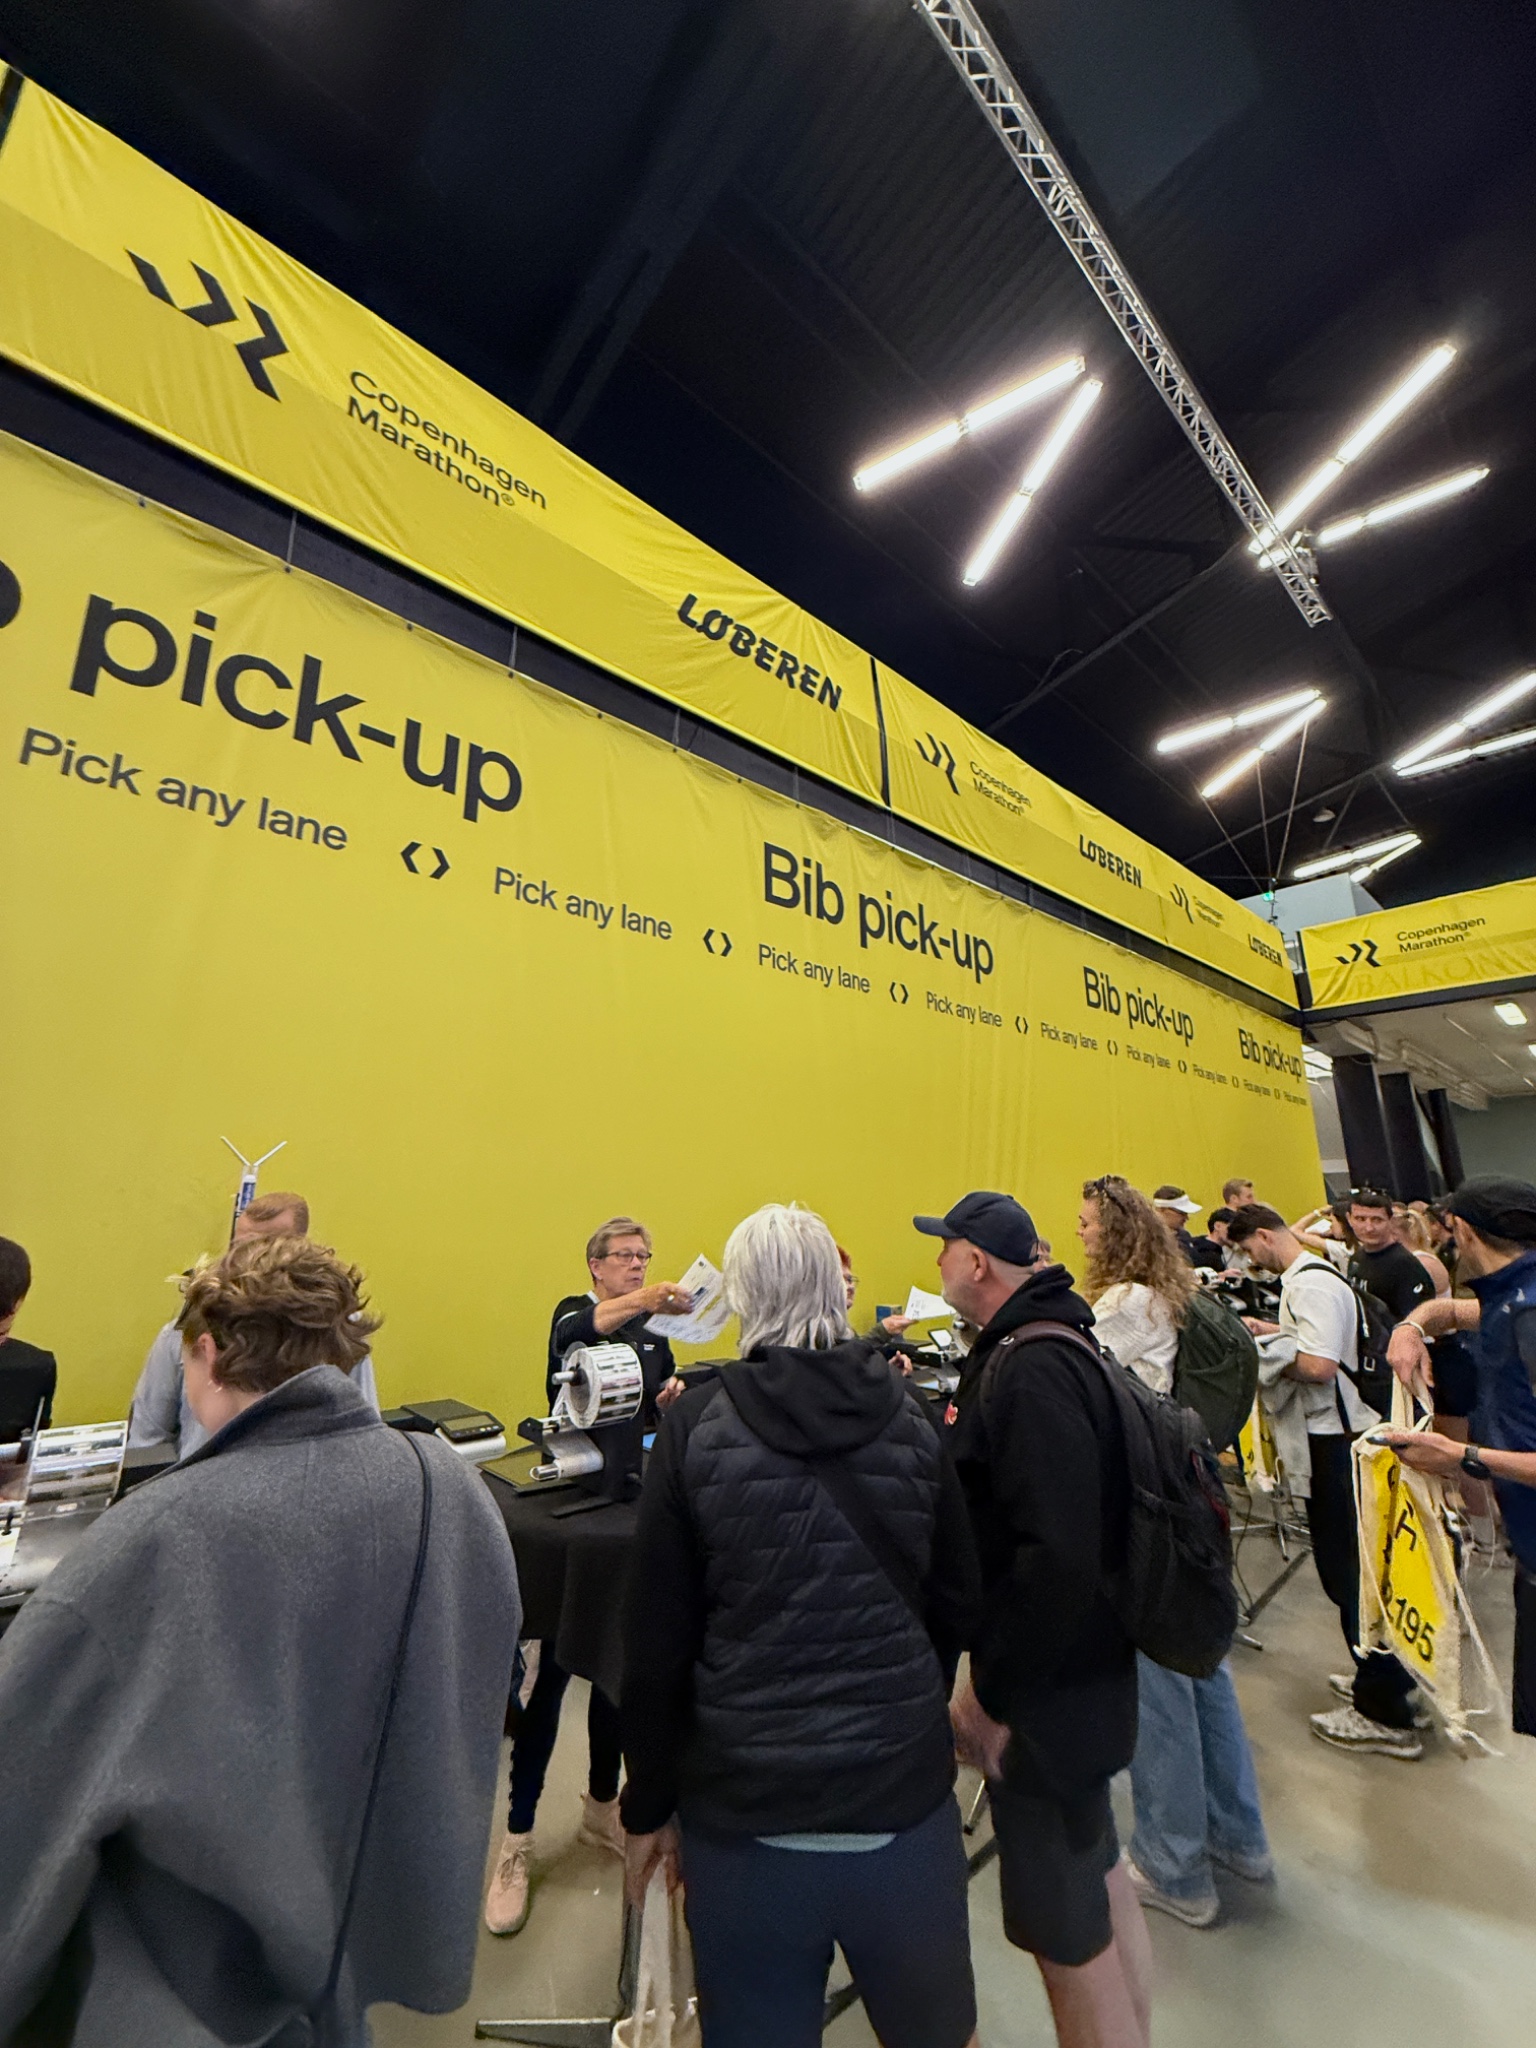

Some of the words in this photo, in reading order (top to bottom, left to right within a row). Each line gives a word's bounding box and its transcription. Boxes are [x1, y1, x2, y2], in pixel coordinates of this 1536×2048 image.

[350, 372, 546, 509] Copenhagen
[70, 594, 522, 823] pick-up
[970, 761, 1031, 808] Copenhagen
[19, 728, 142, 795] Pick
[157, 778, 246, 827] any
[258, 797, 347, 850] lane
[495, 867, 557, 910] Pick
[566, 895, 614, 929] any
[621, 904, 672, 940] lane
[759, 944, 798, 975] Pick
[804, 962, 833, 988] any
[838, 966, 870, 993] lane
[926, 991, 953, 1015] Pick
[956, 1004, 976, 1025] any
[979, 1006, 1002, 1027] lane
[1041, 1022, 1061, 1041] Pick
[1062, 1032, 1077, 1049] any
[1079, 1033, 1098, 1050] lane
[764, 842, 844, 925] Bib
[859, 892, 993, 984] pick-up
[1397, 918, 1485, 941] Copenhagen
[1083, 966, 1121, 1015] Bib
[1126, 987, 1193, 1047] pick-up
[1238, 1028, 1261, 1064] Bib
[1263, 1040, 1301, 1083] pick-up
